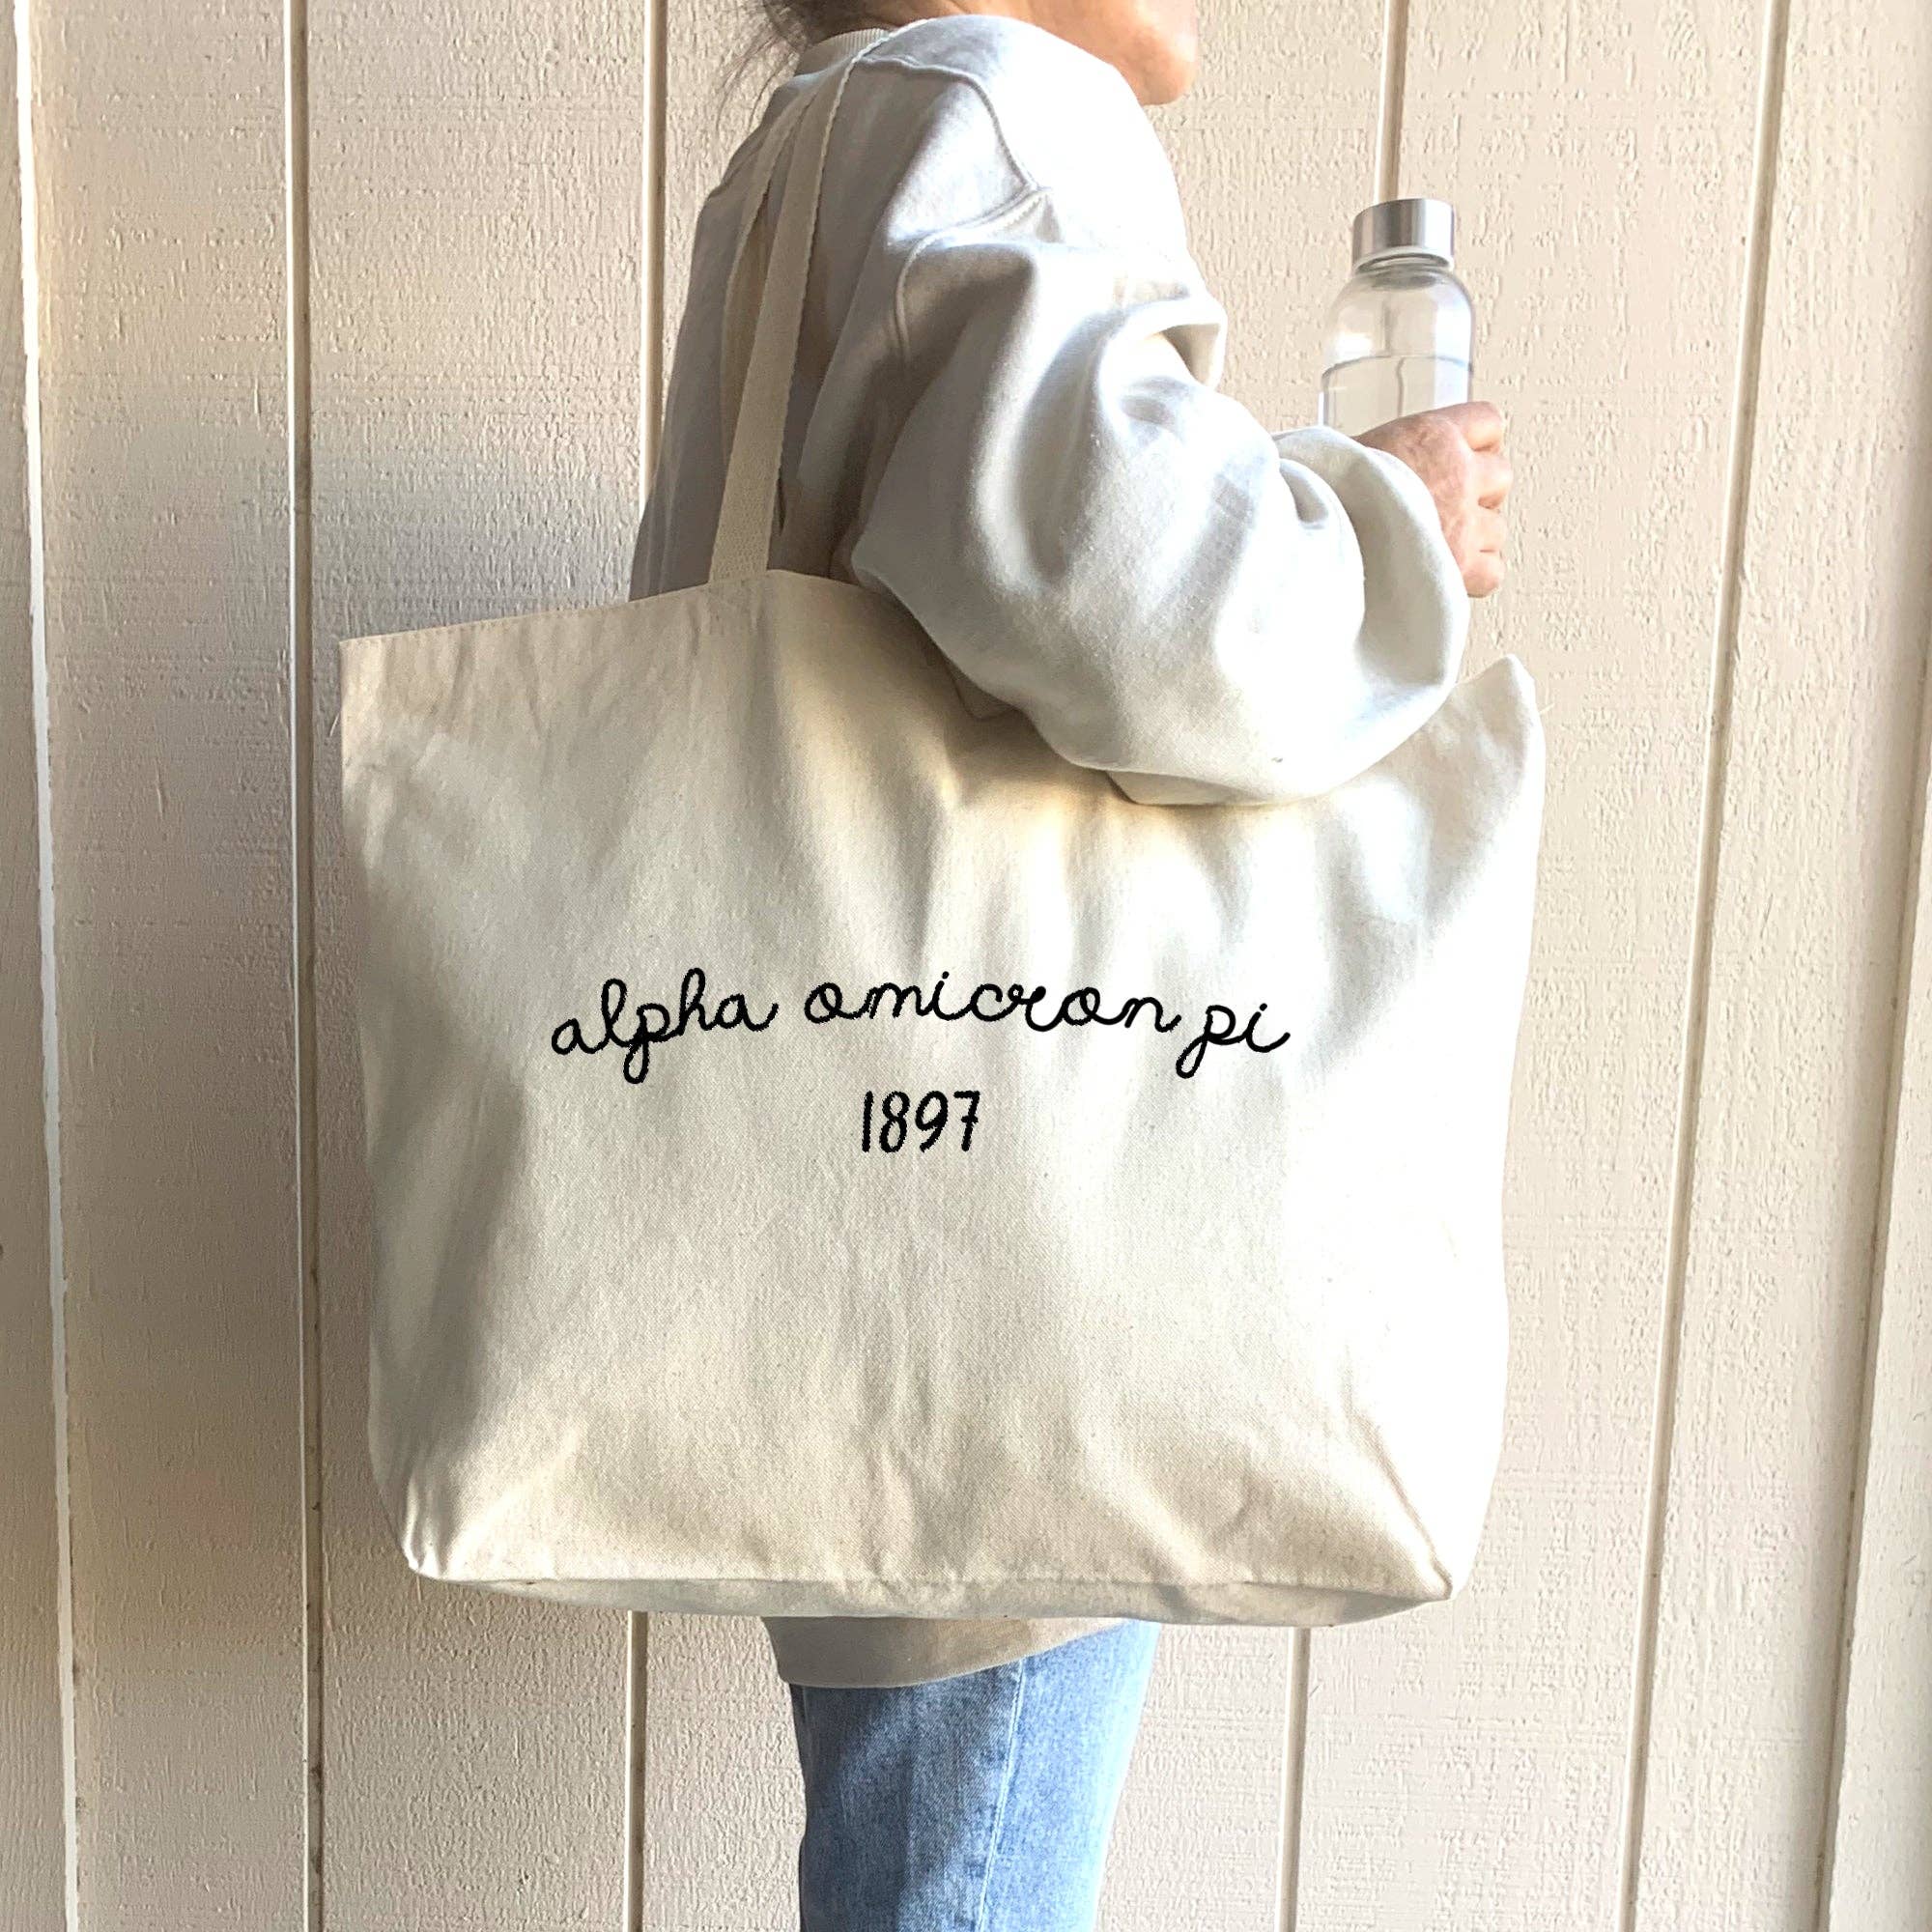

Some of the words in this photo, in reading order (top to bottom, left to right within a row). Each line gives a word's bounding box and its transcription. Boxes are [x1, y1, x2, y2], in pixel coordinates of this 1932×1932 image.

[551, 967, 780, 1084] alpha
[803, 971, 1181, 1033] omicron
[1175, 1003, 1292, 1079] pi
[861, 1090, 980, 1153] 1897
